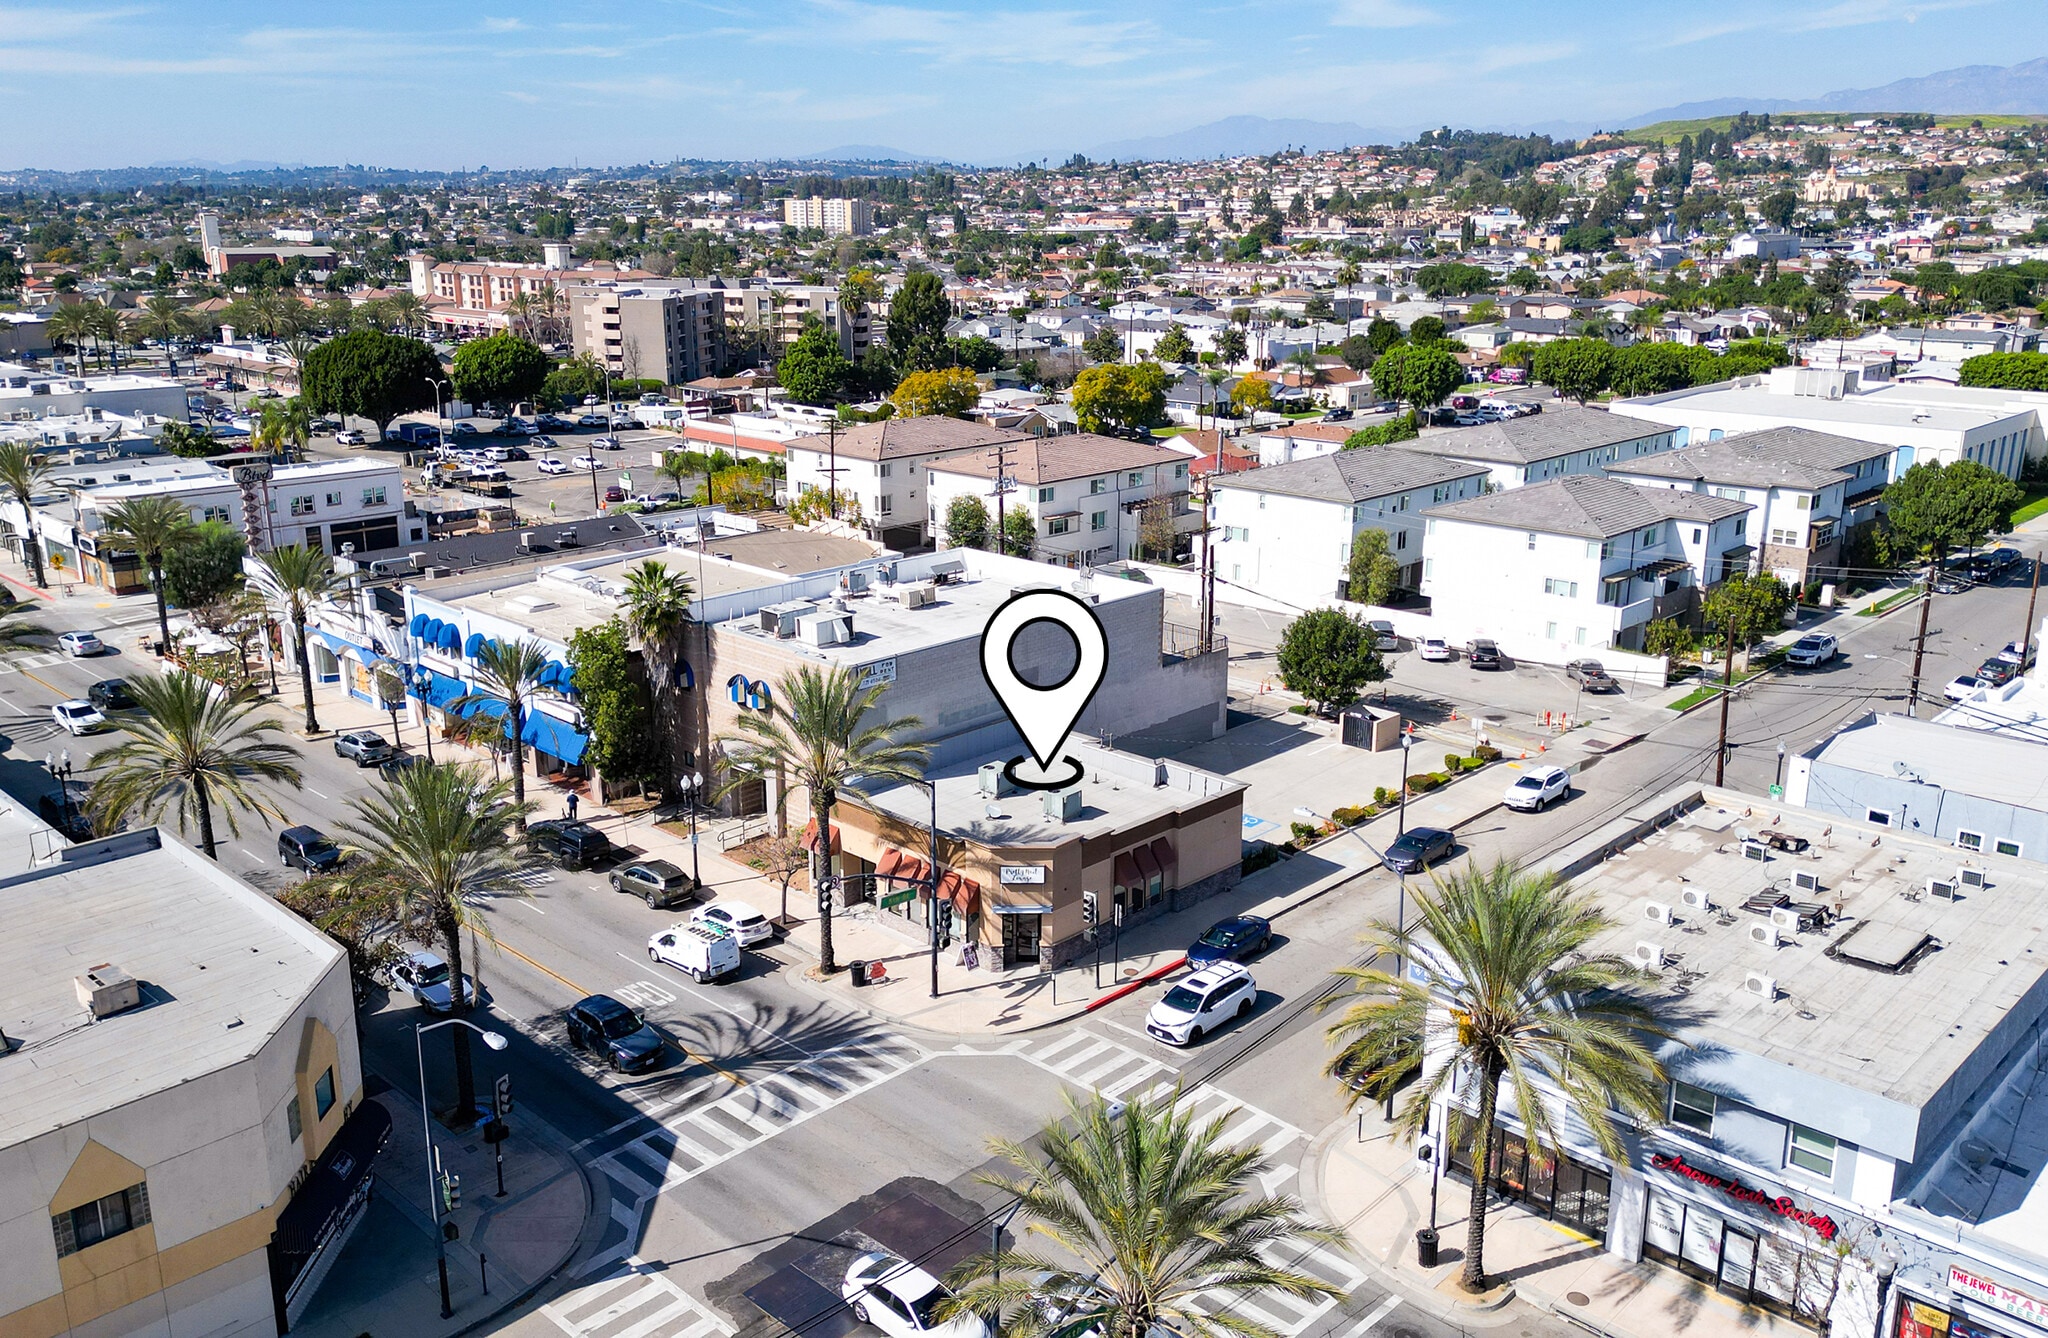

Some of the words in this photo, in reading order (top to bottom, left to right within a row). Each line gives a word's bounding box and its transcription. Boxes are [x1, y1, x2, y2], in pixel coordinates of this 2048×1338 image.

[239, 467, 270, 481] Blvd
[344, 630, 363, 645] OUTLET
[613, 980, 677, 1011] PED
[1651, 1154, 1721, 1189] Amour
[1724, 1179, 1767, 1206] Lash
[1768, 1196, 1837, 1241] Society
[1952, 1270, 1969, 1285] THE
[1969, 1276, 1997, 1297] JEWEL
[1960, 1285, 1996, 1305] COLD
[2006, 1303, 2044, 1325] BEER
